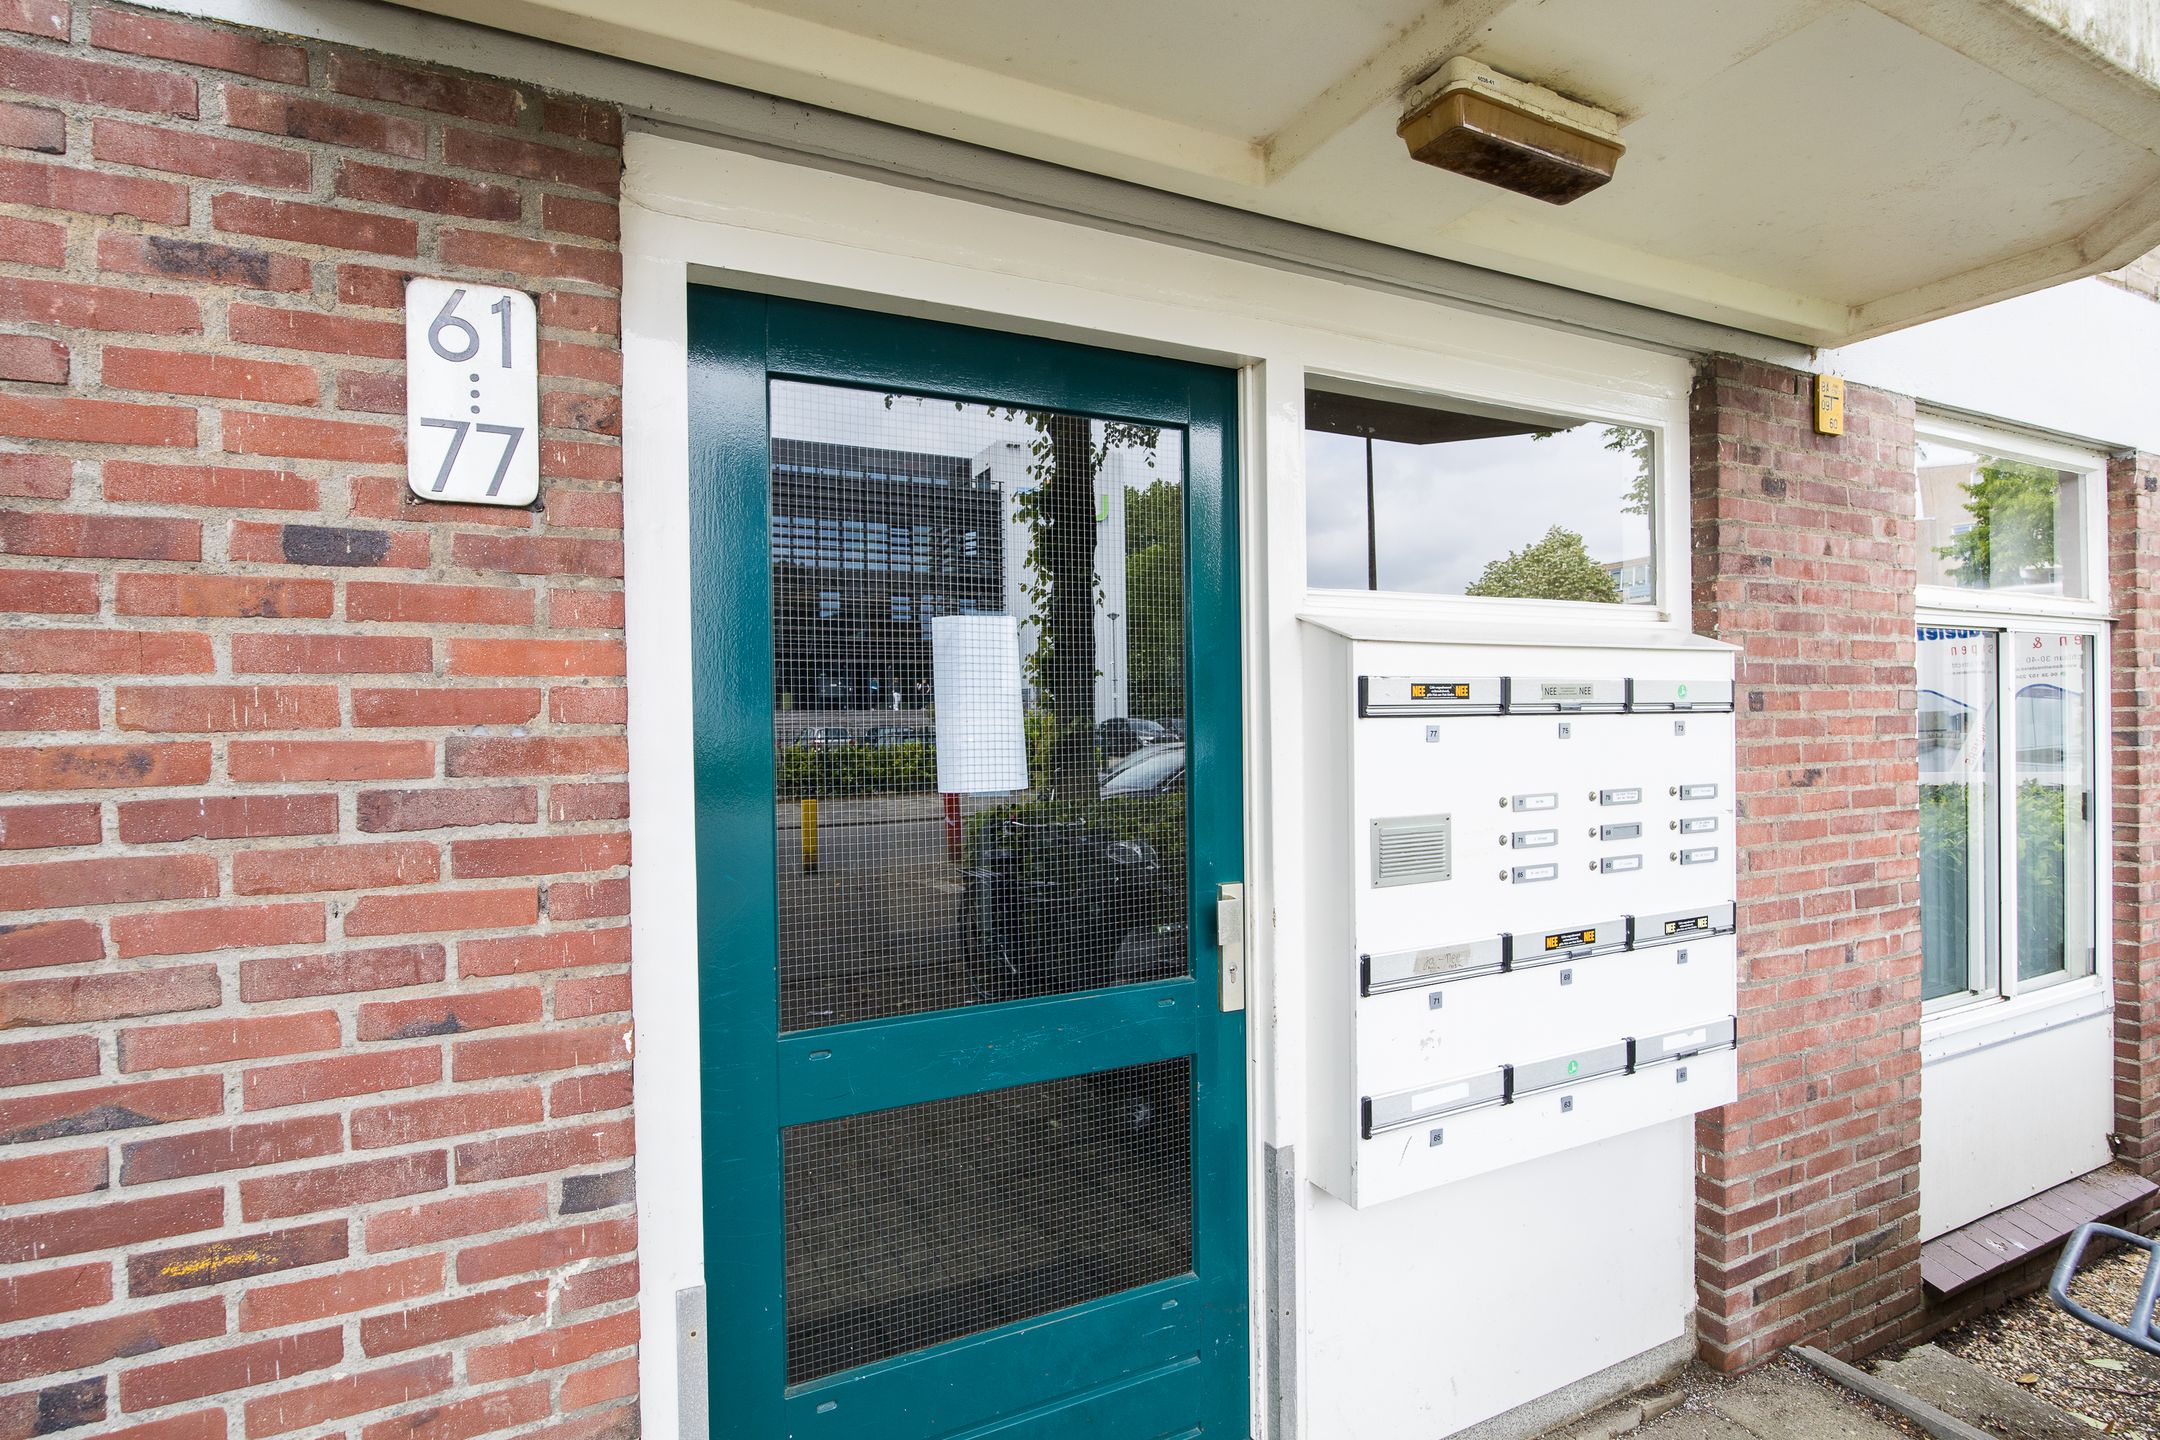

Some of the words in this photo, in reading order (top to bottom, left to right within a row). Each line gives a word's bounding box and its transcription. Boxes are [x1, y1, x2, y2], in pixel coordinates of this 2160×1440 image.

[428, 289, 512, 369] 61
[420, 417, 525, 497] 77
[1412, 685, 1426, 697] NEE
[1455, 685, 1469, 697] NEE
[1544, 687, 1557, 696] NEE
[1578, 686, 1592, 695] NEE
[1665, 922, 1676, 934] NEE
[1697, 917, 1708, 929] NEE
[1583, 930, 1595, 942] NEE
[1546, 936, 1559, 949] NEE
[1433, 997, 1440, 1005] 71
[1433, 1133, 1441, 1142] 65
